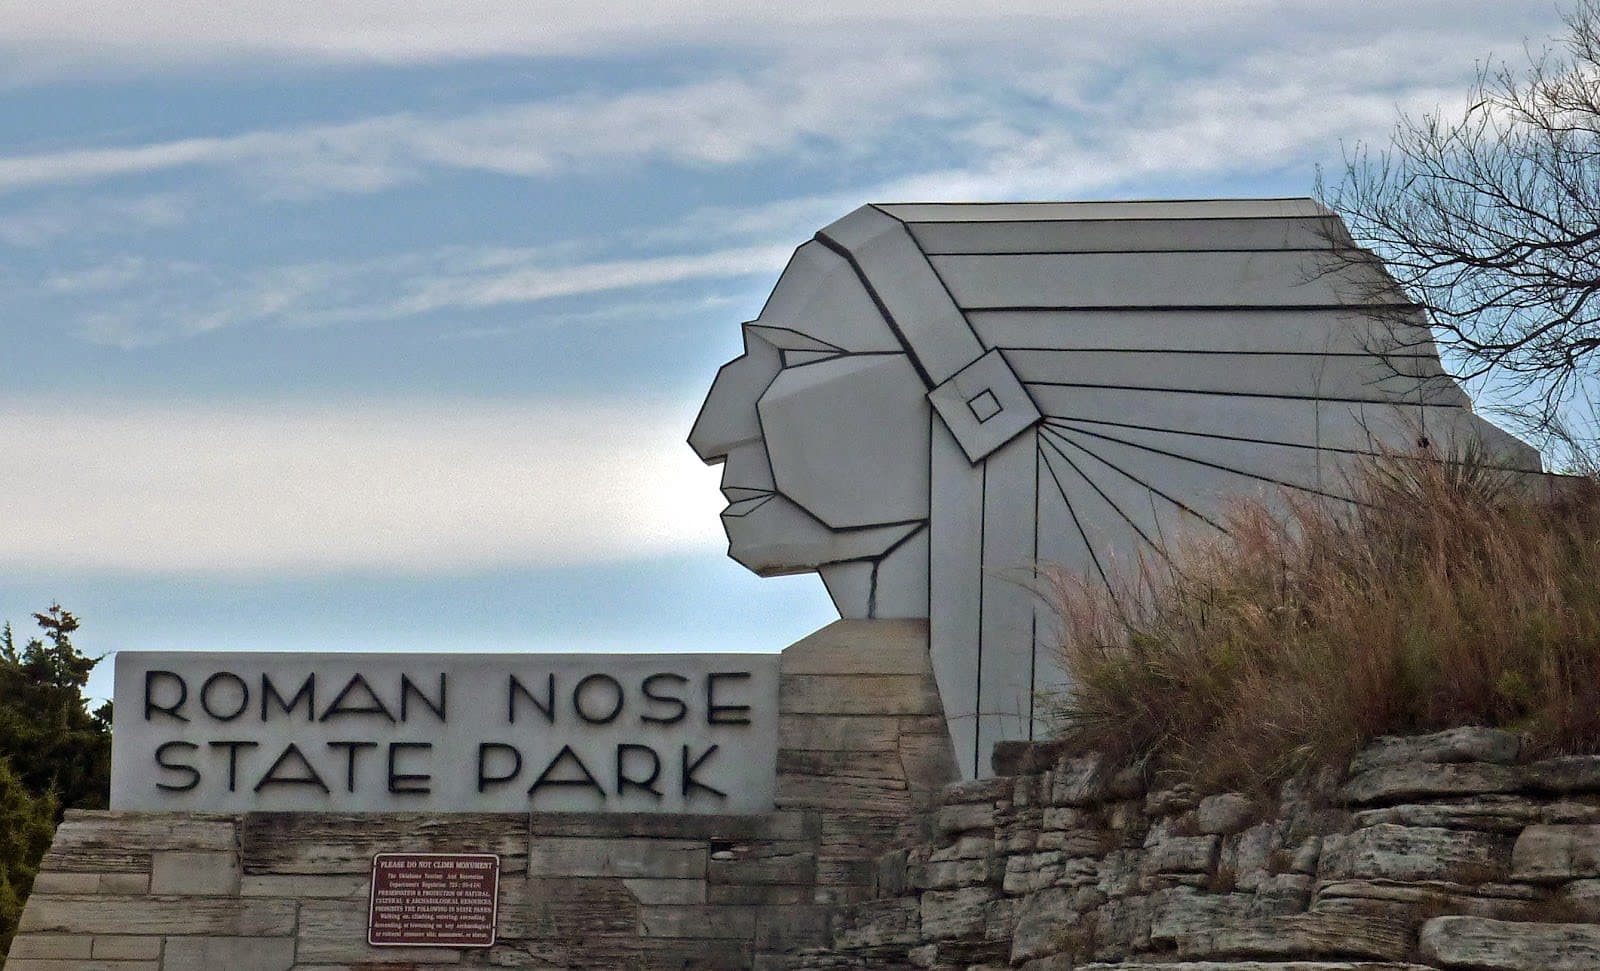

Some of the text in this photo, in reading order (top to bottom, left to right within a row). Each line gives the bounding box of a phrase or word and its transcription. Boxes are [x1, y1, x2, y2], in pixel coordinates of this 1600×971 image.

[144, 671, 751, 727] ROMAN NOSE
[155, 741, 727, 799] STATE PARK
[381, 861, 493, 869] PLEASE DO NOT CLIMB MONUMENT
